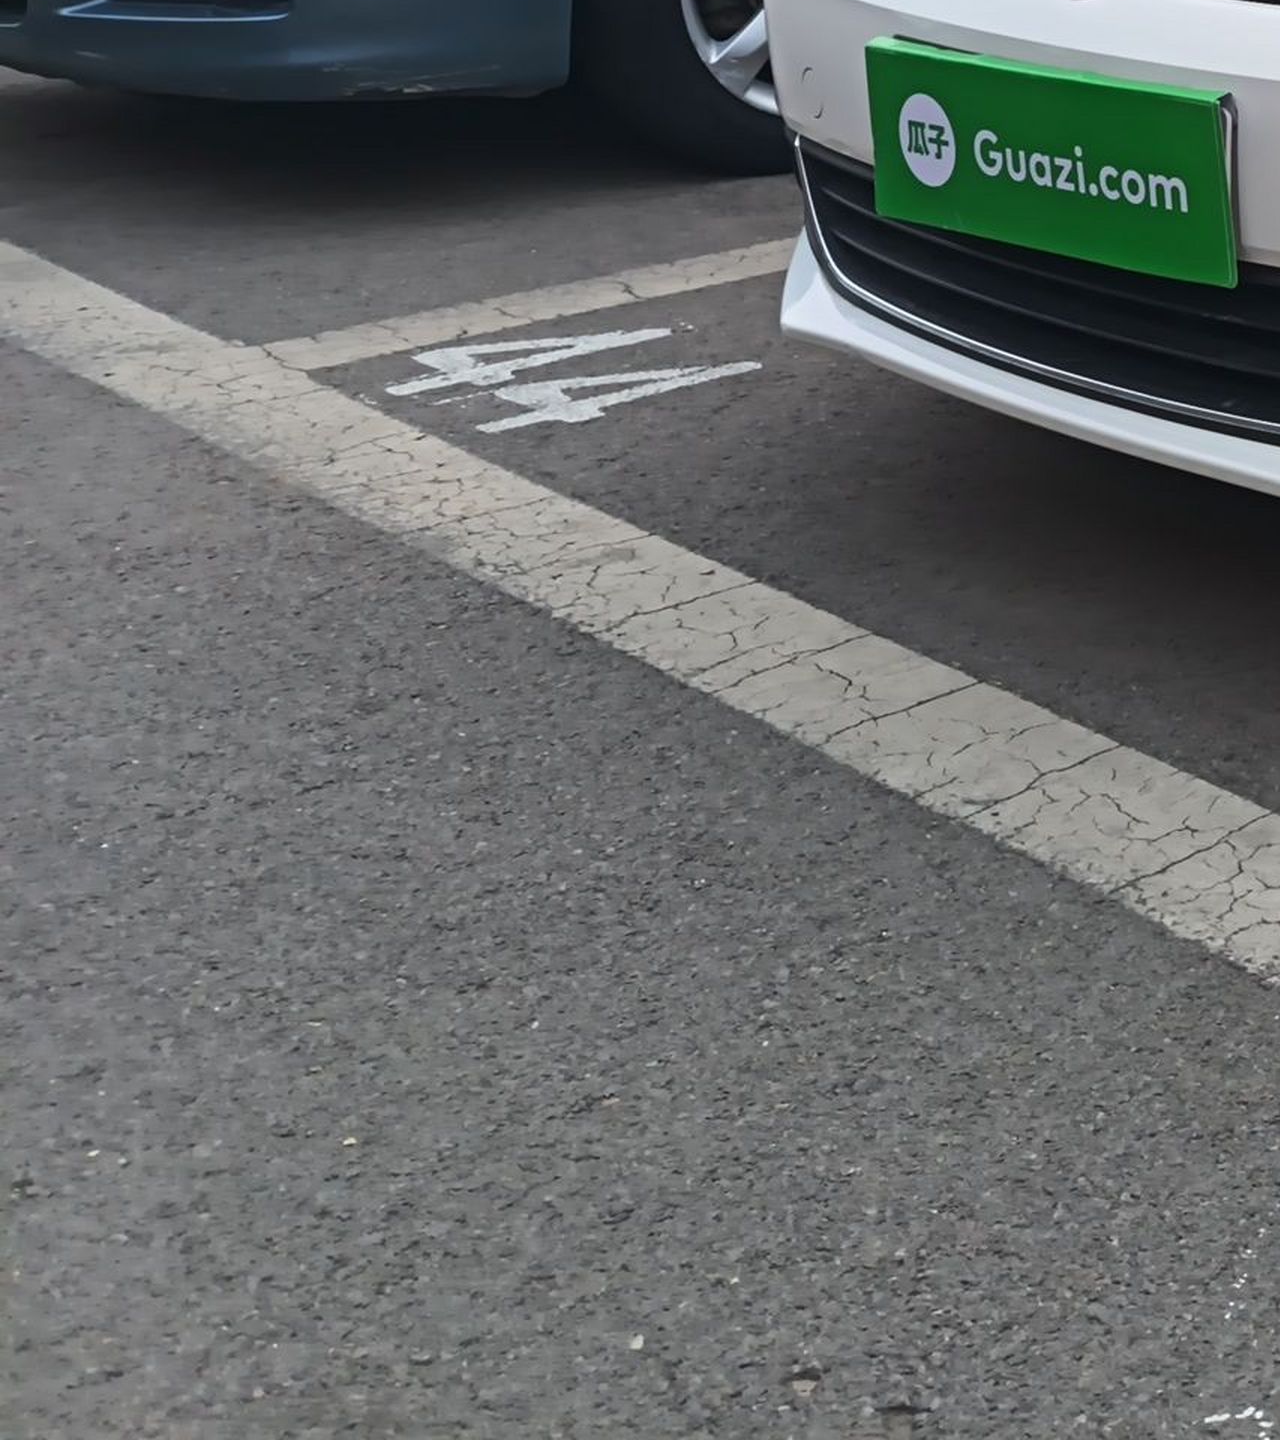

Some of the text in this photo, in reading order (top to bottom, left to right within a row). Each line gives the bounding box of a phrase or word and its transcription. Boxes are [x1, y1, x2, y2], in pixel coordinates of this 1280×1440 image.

[907, 120, 949, 159] 瓜子
[973, 130, 1189, 213] Guazi.com
[386, 327, 763, 433] 44
